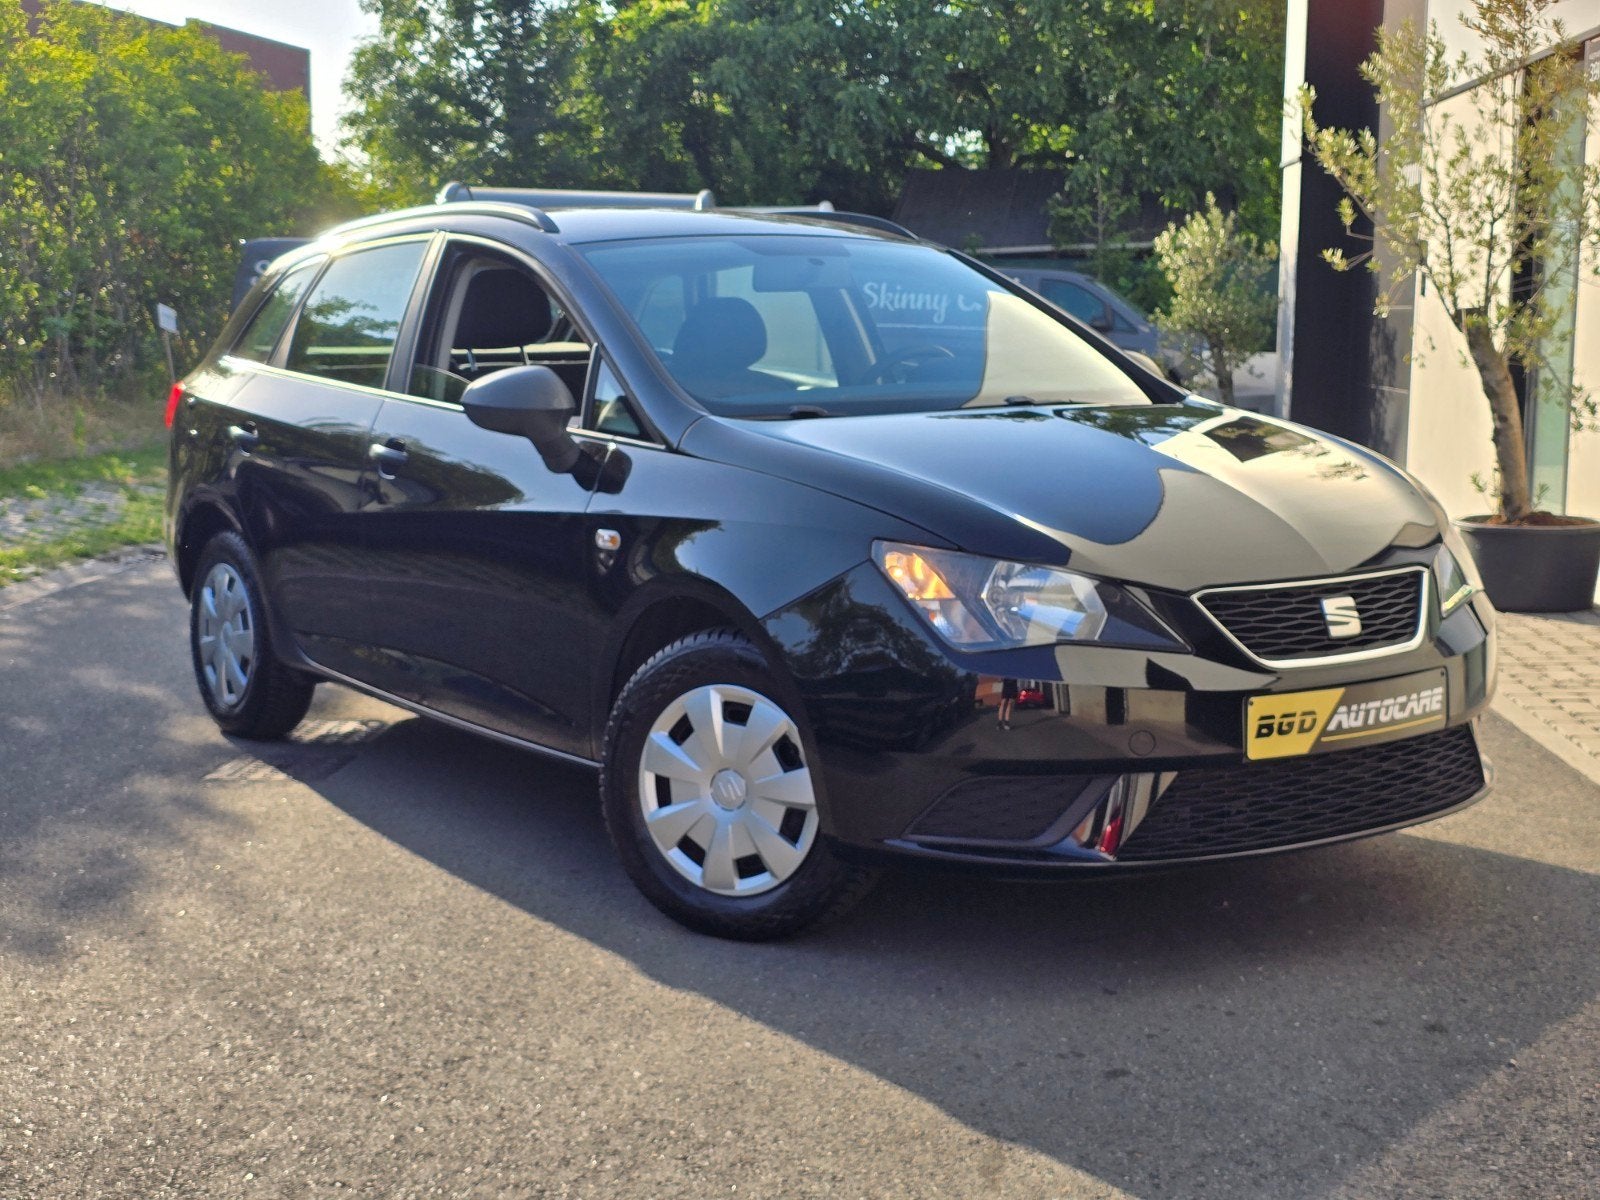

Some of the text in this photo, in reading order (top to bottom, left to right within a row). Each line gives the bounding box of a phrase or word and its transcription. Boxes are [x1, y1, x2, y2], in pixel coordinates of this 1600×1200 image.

[863, 282, 949, 323] Skinny
[1255, 687, 1443, 739] BGD AUTOCARE
